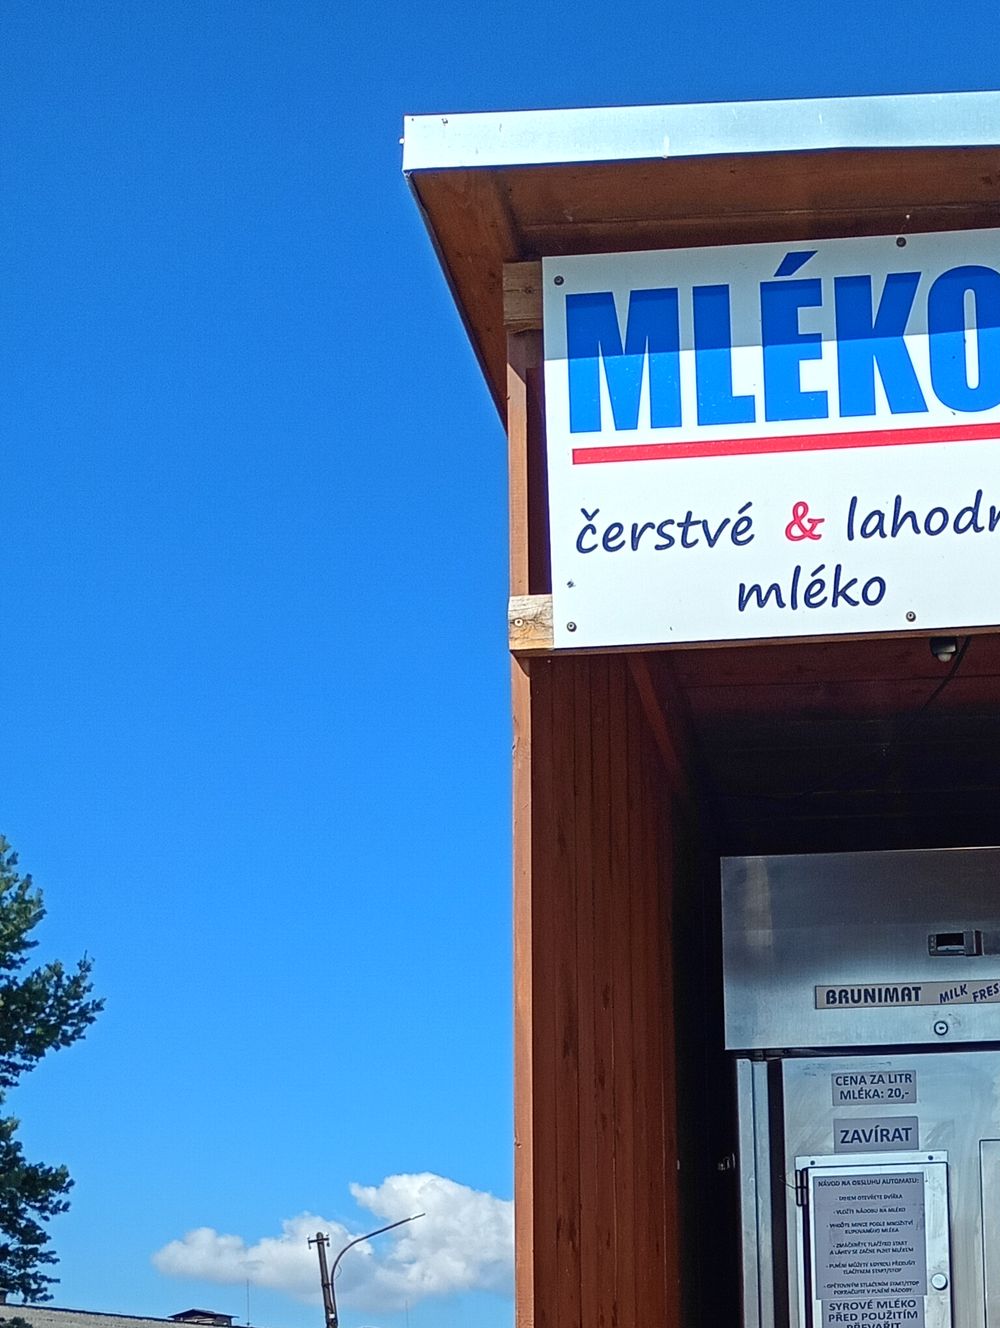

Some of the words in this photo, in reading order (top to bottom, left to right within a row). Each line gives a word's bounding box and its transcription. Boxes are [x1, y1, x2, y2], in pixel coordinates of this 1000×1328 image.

[575, 502, 755, 554] čerstvé
[784, 501, 826, 542] &
[738, 565, 887, 613] mléko
[826, 986, 922, 1005] BRUNIMAT
[939, 984, 968, 1004] MILK
[835, 1076, 867, 1087] CENA
[870, 1075, 886, 1085] ZA
[888, 1073, 913, 1084] LITR
[839, 1086, 884, 1101] MLÉKA:
[887, 1088, 910, 1100] 20,-
[840, 1125, 912, 1144] ZAVÍRAT
[829, 1298, 874, 1311] SYROVÉ
[876, 1297, 917, 1309] MLÉKO
[828, 1311, 858, 1322] PŘED
[861, 1310, 918, 1321] POUŽITÍM
